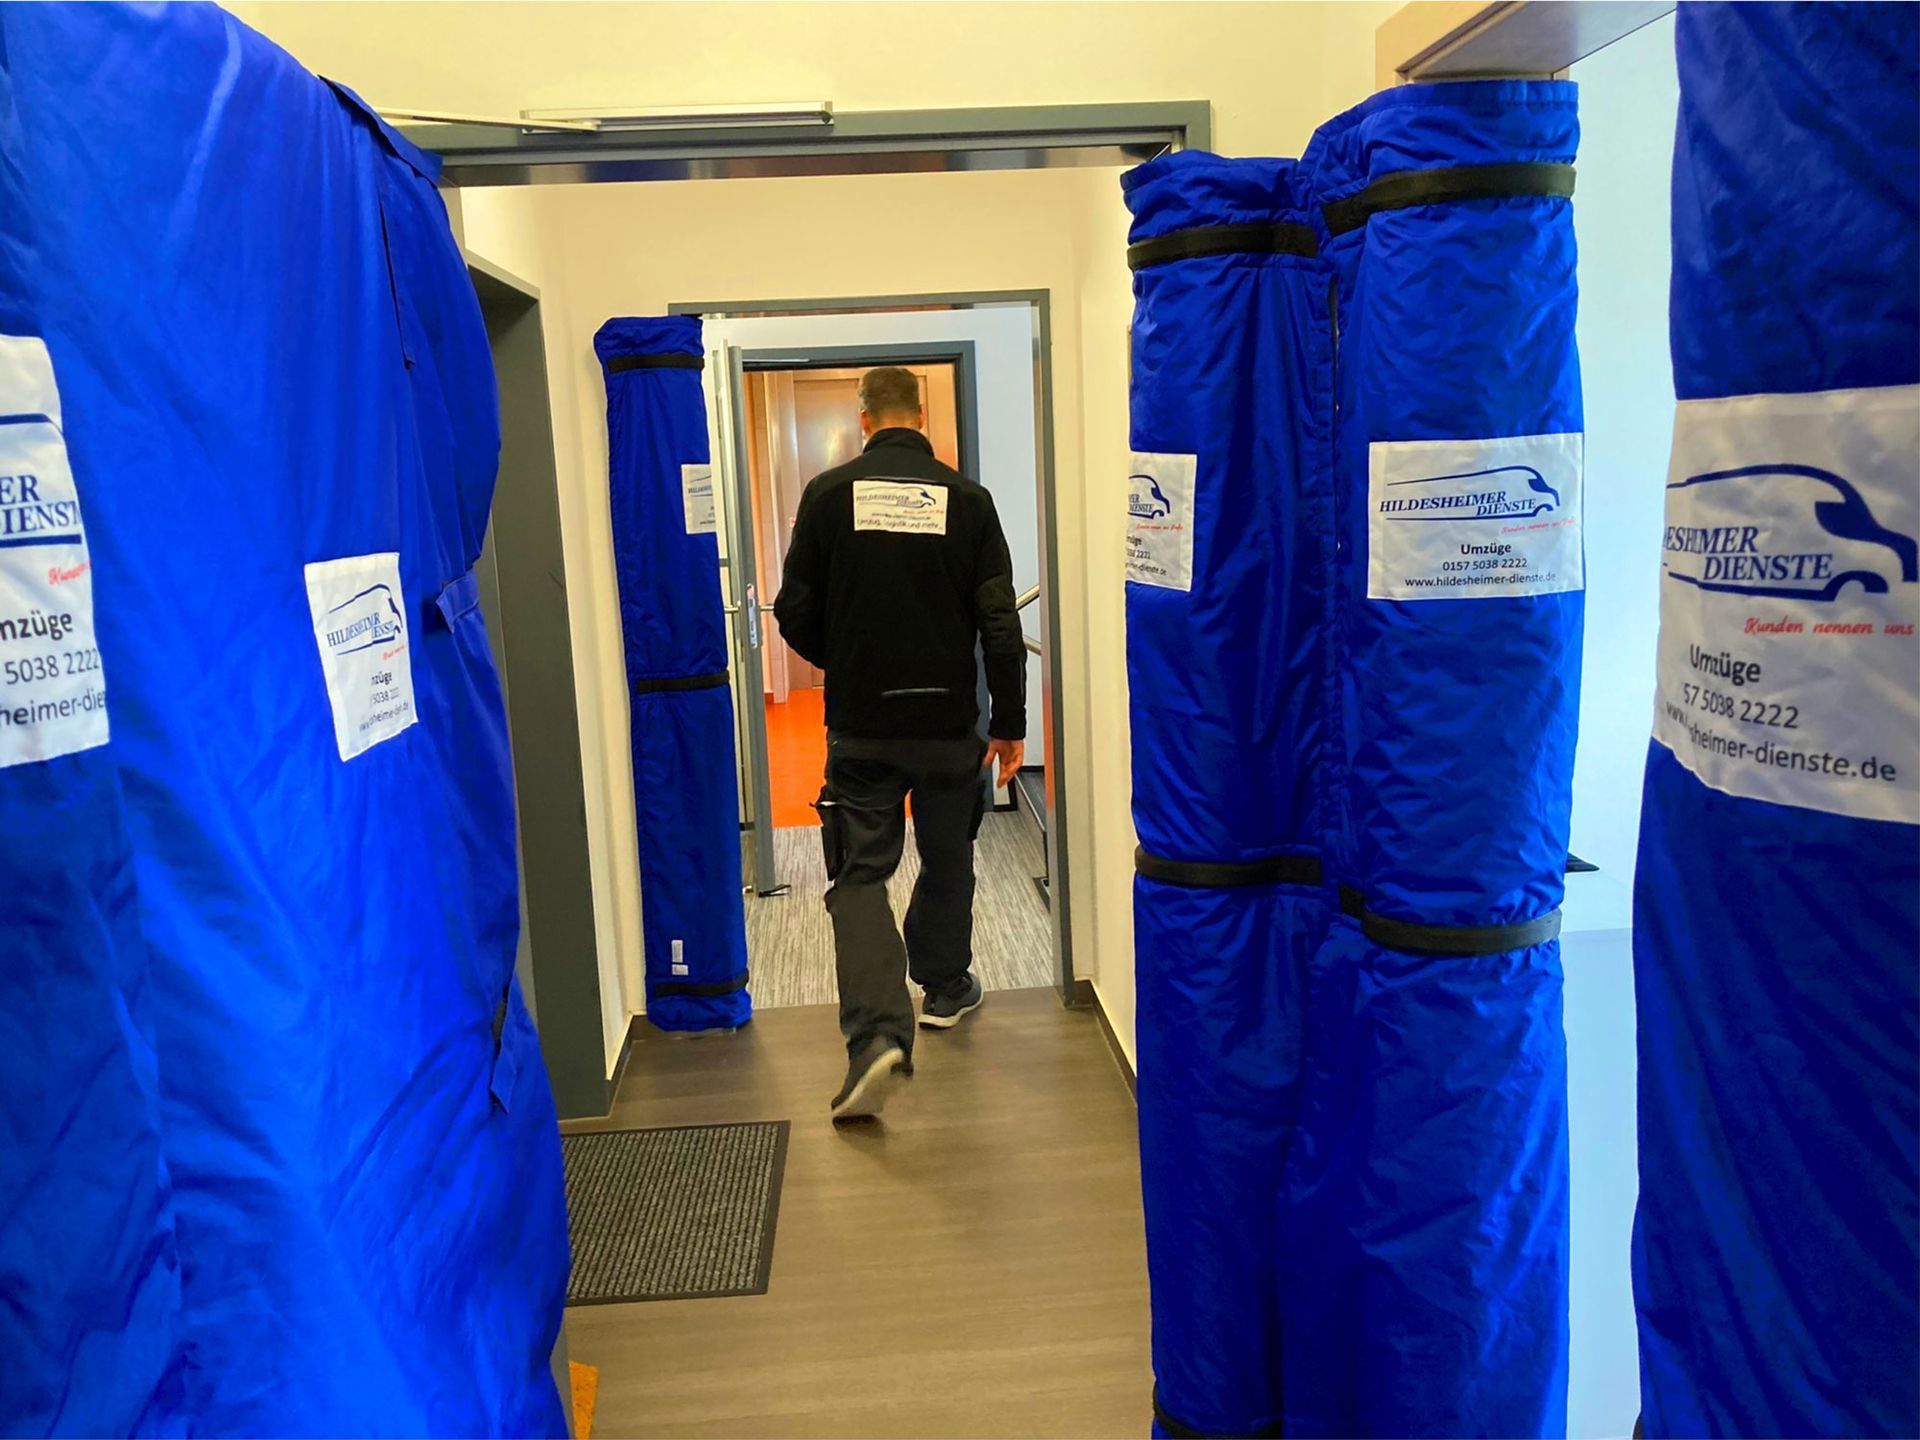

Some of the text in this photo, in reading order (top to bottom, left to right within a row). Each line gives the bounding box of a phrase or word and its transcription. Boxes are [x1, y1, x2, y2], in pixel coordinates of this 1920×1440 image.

[1379, 491, 1506, 513] HILDESHEIMER
[1476, 499, 1536, 516] DIENSTE
[1461, 542, 1512, 555] Umzüge
[1442, 558, 1527, 571] 0157 5038 2222
[1703, 553, 1833, 582] DIENSTE
[1404, 572, 1556, 587] www.hildesheimer-dienste.de
[1744, 616, 1915, 635] Kunden nennen uns
[4, 648, 99, 685] 5038 2222
[1690, 643, 1761, 686] Umzüge
[1701, 689, 1735, 718] 5038
[1740, 700, 1799, 729] 2222
